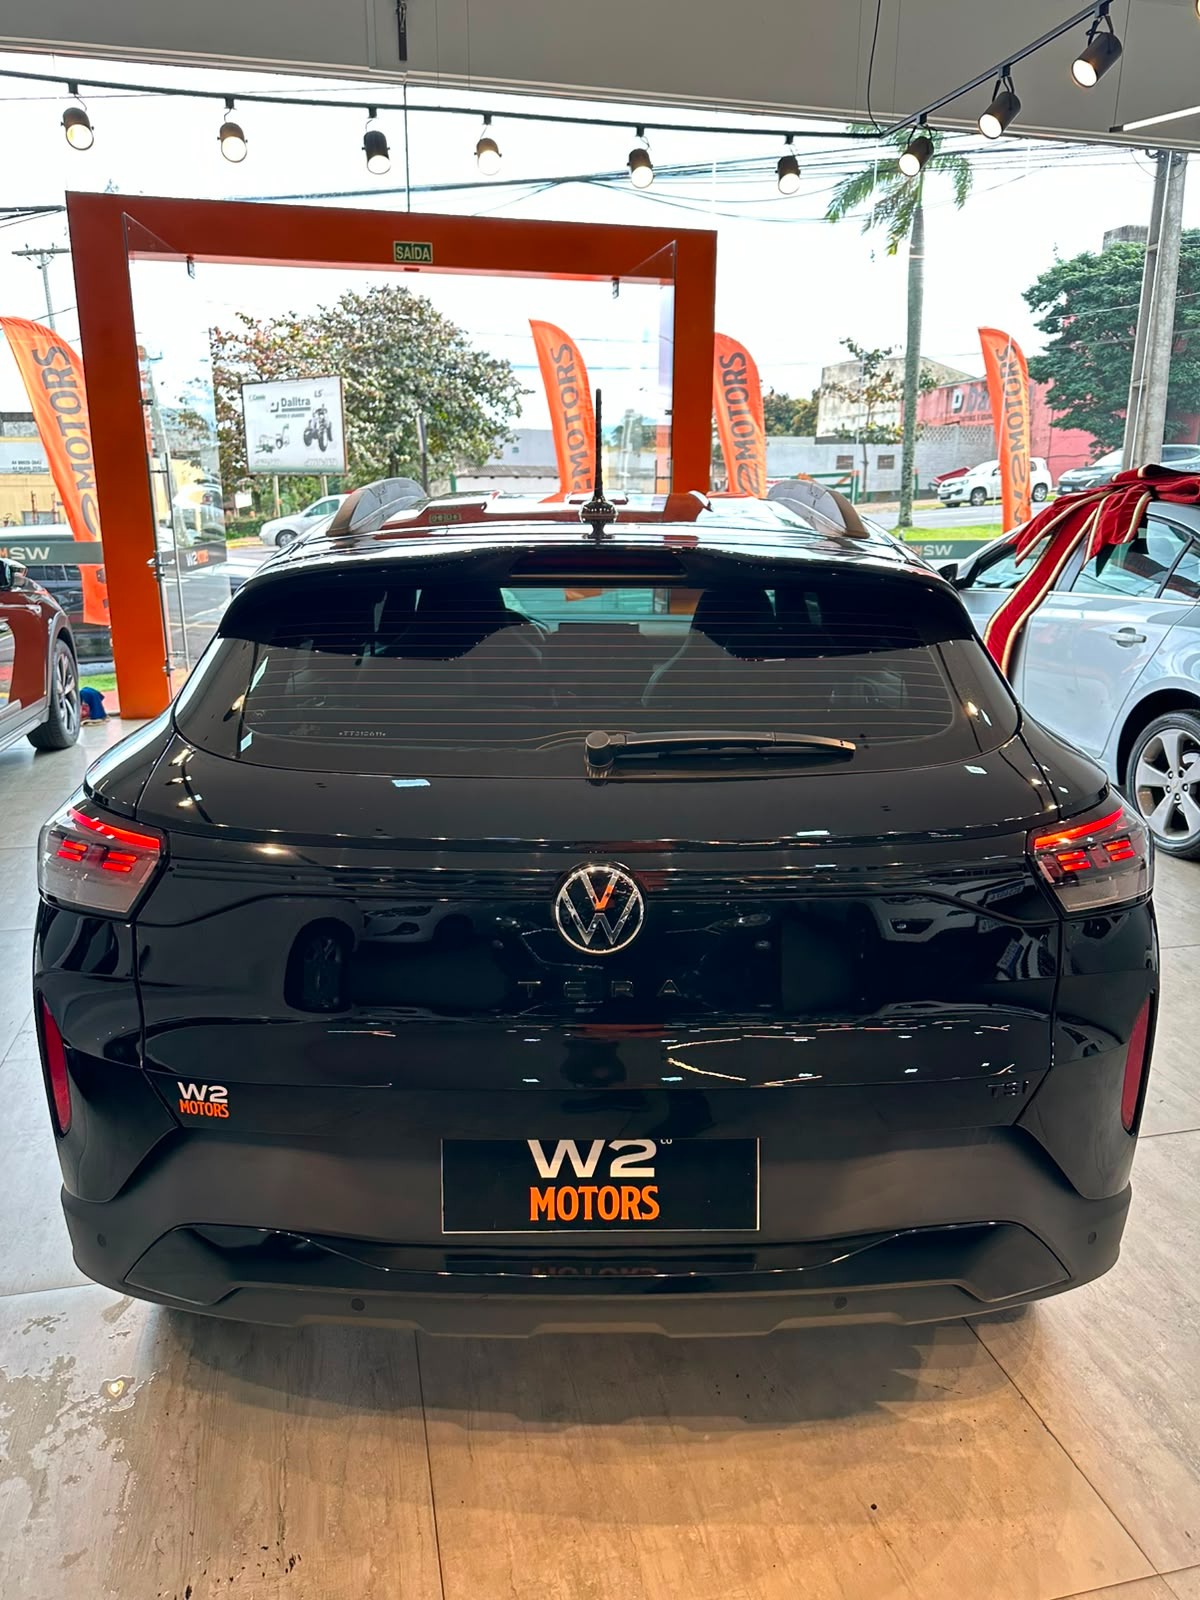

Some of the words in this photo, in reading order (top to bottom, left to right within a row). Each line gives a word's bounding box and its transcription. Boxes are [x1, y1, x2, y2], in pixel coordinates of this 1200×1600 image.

[396, 243, 430, 260] SAÍDA
[32, 345, 96, 489] MOTORS
[550, 343, 591, 474] MOTORS
[719, 352, 757, 464] MOTORS
[994, 344, 1026, 453] MOTORS
[555, 866, 644, 954] VW
[518, 979, 683, 999] TERA
[177, 1081, 228, 1103] W2
[179, 1099, 230, 1118] MOTORS
[527, 1138, 657, 1178] W2
[529, 1186, 660, 1221] MOTORS
